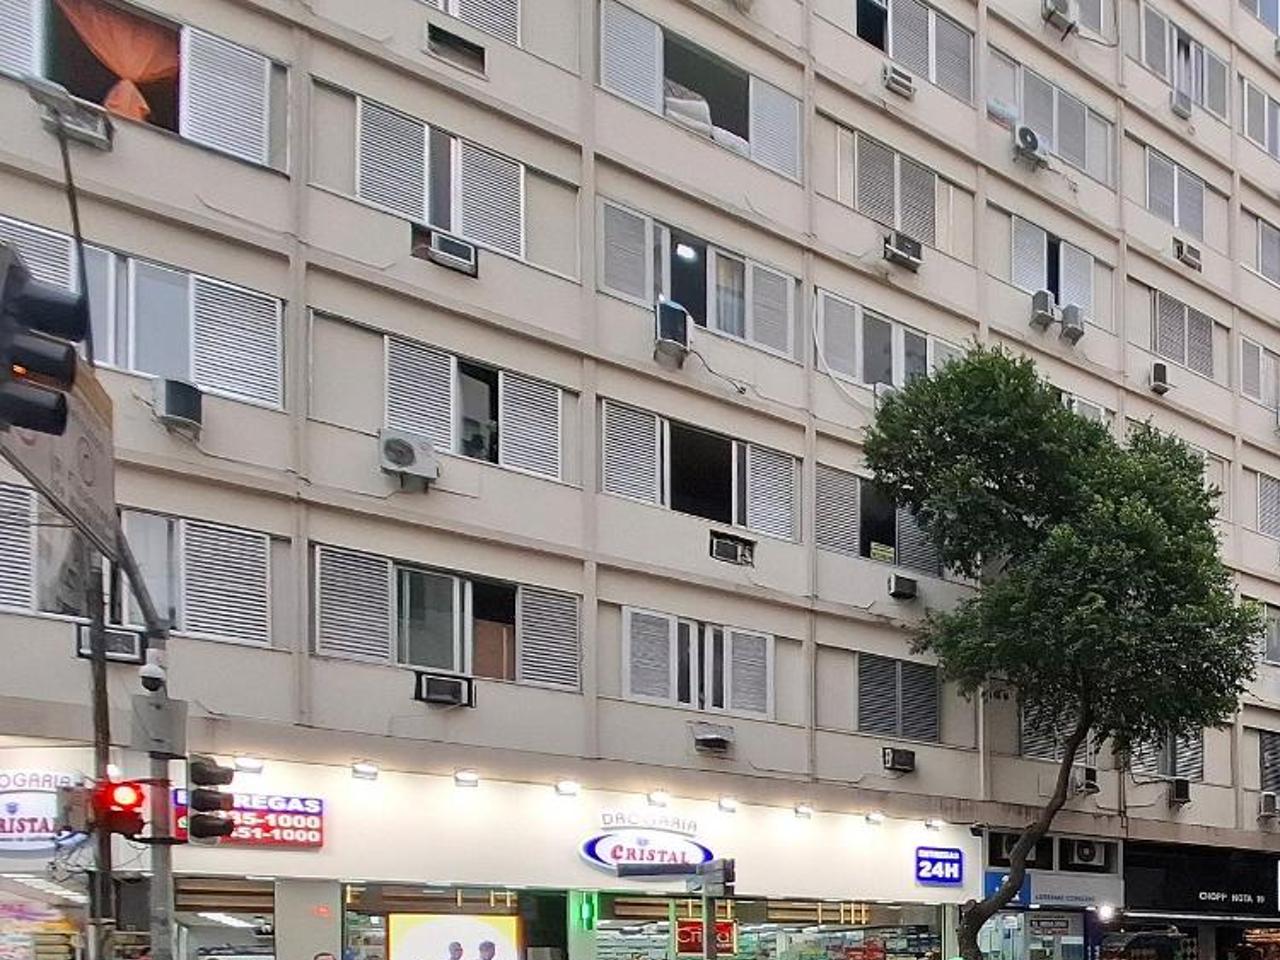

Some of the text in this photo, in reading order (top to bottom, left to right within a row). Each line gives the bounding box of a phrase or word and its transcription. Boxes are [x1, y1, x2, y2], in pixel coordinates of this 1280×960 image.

[176, 788, 321, 813] EREGAS
[610, 844, 690, 864] CRISTAL
[918, 860, 960, 879] 24H
